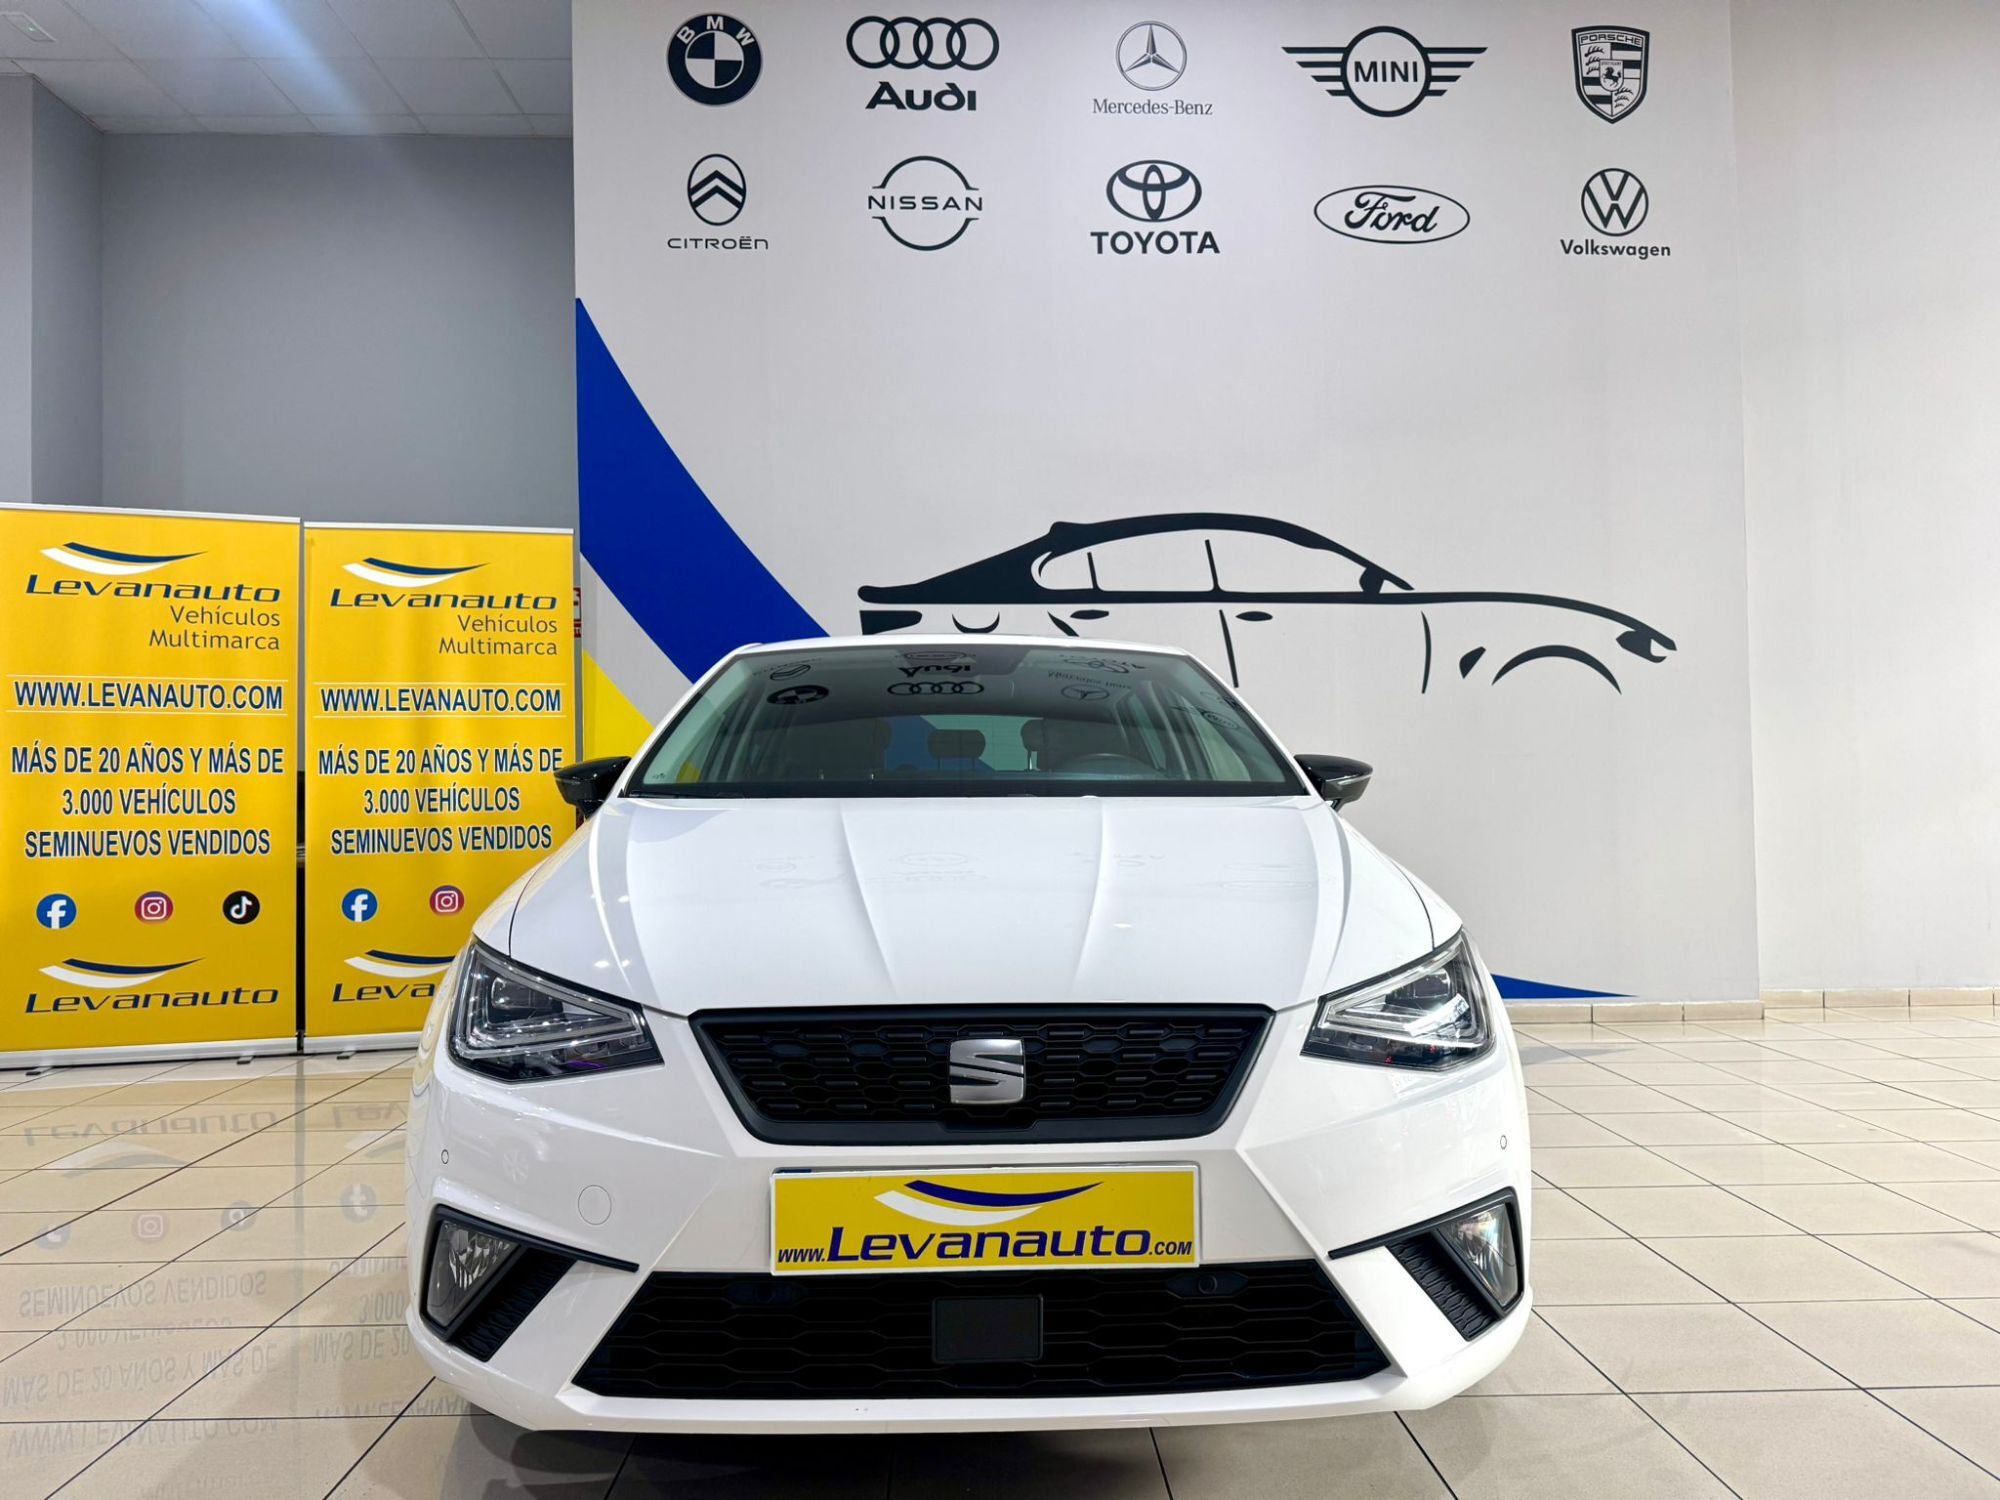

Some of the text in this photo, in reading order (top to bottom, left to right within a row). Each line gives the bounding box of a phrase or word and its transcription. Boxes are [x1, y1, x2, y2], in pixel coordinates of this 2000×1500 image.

[676, 15, 755, 47] BMW
[1580, 33, 1642, 45] PORSCHE
[1354, 60, 1419, 83] MINI
[865, 81, 977, 111] Audi
[1092, 98, 1213, 116] Mercedes-Benz
[867, 194, 983, 212] NISSAN
[1344, 191, 1440, 233] Ford
[667, 236, 769, 250] CITROËN
[1090, 231, 1220, 255] TOYOTA
[1560, 239, 1672, 260] Volkswagen
[25, 574, 281, 602] Levanauto
[330, 588, 557, 610] Levanauto
[170, 605, 281, 628] Vehículos
[457, 614, 558, 634] Vehículos
[148, 629, 281, 651] Multimarca
[438, 636, 558, 656] Multimarca
[15, 680, 283, 710] WWW.LEVANAUTO.COM
[320, 688, 561, 712] WWW.LEVANAUTO.COM
[11, 741, 284, 774] MÁS DE 20 AÑOS Y MÁS DE
[318, 742, 563, 775] MÁS DE 20 AÑOS Y MÁS DE
[62, 782, 236, 815] 3.000 VEHÍCULOS
[364, 782, 520, 813] 3.000 VEHÍCULOS
[24, 828, 271, 858] SEMINUEVOS VENDIDOS
[331, 825, 552, 855] SEMINUEVOS VENDIDOS
[24, 988, 279, 1013] Levanauto
